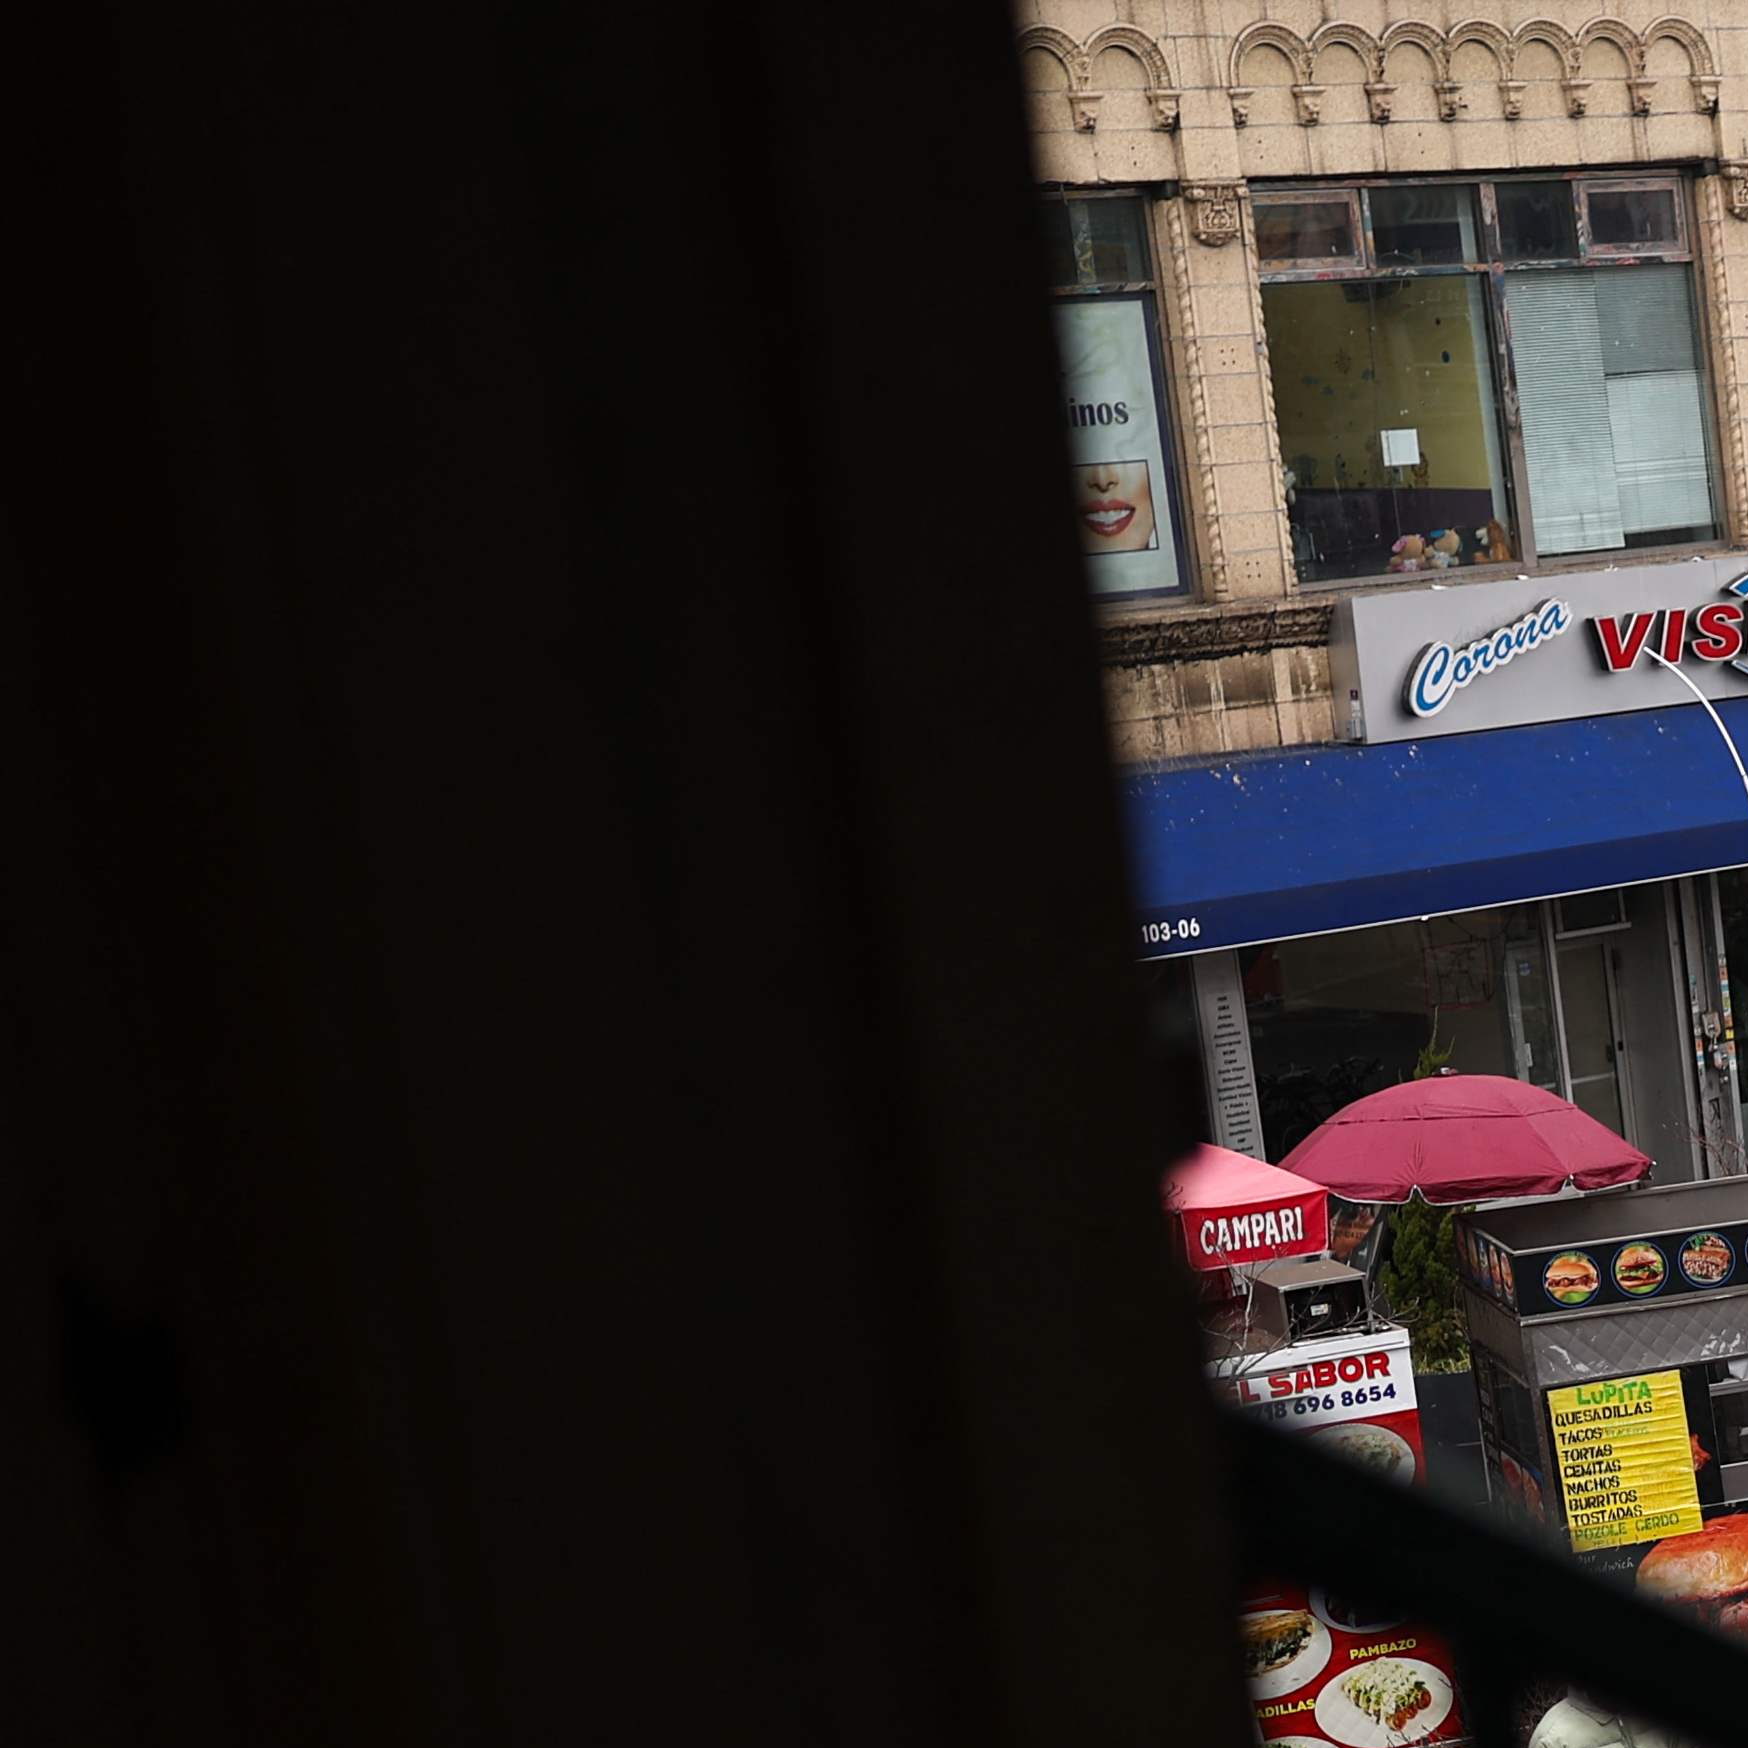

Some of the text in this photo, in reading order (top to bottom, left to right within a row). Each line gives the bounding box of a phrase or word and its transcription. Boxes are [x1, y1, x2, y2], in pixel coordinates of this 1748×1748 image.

[1410, 597, 1572, 718] Corona
[1142, 917, 1200, 943] 103-06
[1201, 1207, 1304, 1255] CAMPARI
[1269, 1351, 1390, 1399] SABOR
[1294, 1395, 1334, 1415] 696
[1341, 1383, 1397, 1408] 8654
[1555, 1401, 1653, 1427] QUESADILLAS
[1559, 1427, 1602, 1446] TACOS
[1562, 1444, 1613, 1463] TORTAS
[1564, 1459, 1622, 1479] CEMITAS
[1567, 1476, 1620, 1496] NACHOS
[1569, 1490, 1638, 1512] BURRITOS
[1572, 1504, 1643, 1528] TOSTADAS
[1575, 1522, 1627, 1542] POZOLE
[1635, 1513, 1680, 1532] CERDO
[1350, 1638, 1416, 1659] PAMBAZO
